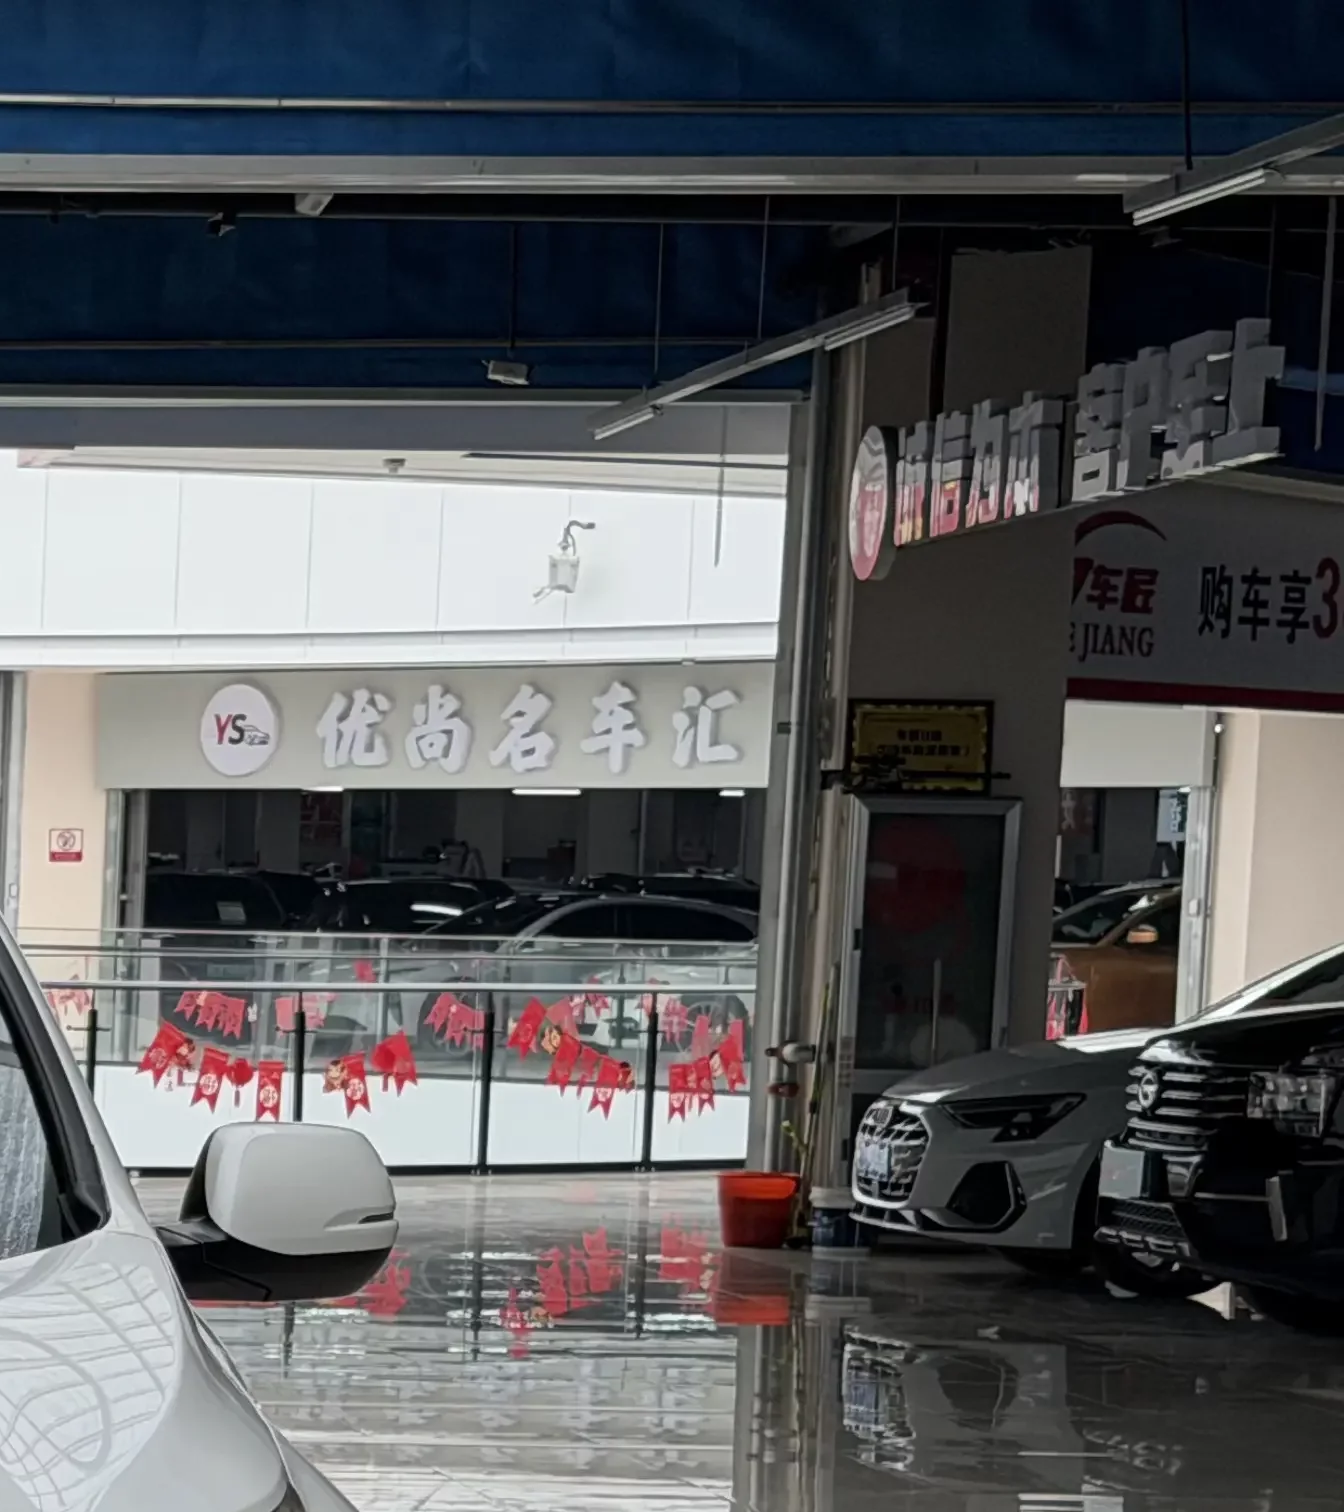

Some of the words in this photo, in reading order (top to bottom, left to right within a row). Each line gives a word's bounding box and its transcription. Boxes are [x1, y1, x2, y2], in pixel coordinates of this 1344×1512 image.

[213, 712, 249, 746] YS
[315, 681, 741, 773] 优尚名车汇
